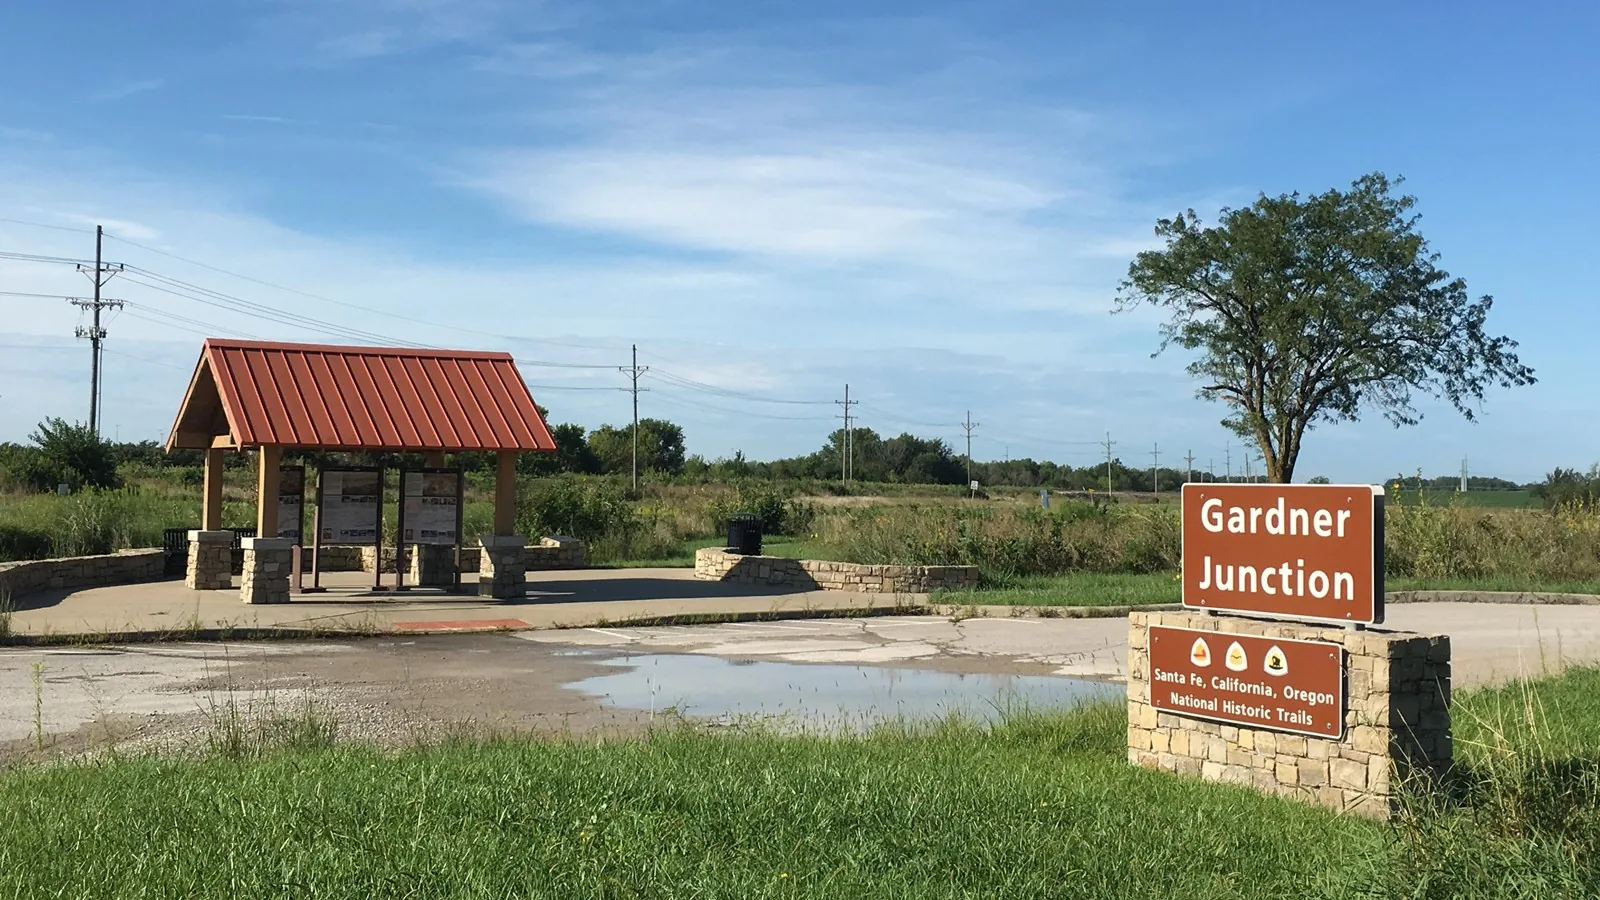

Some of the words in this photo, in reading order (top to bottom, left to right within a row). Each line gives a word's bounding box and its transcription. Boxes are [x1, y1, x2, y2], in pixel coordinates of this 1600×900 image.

[1201, 496, 1351, 537] Gardner
[1199, 555, 1354, 601] Junction
[1154, 668, 1186, 685] Santa
[1190, 672, 1207, 690] Fe,
[1211, 676, 1278, 699] California,
[1283, 685, 1334, 706] Oregon
[1170, 691, 1218, 712] National
[1222, 699, 1271, 720] Historic
[1276, 707, 1313, 726] Trails
